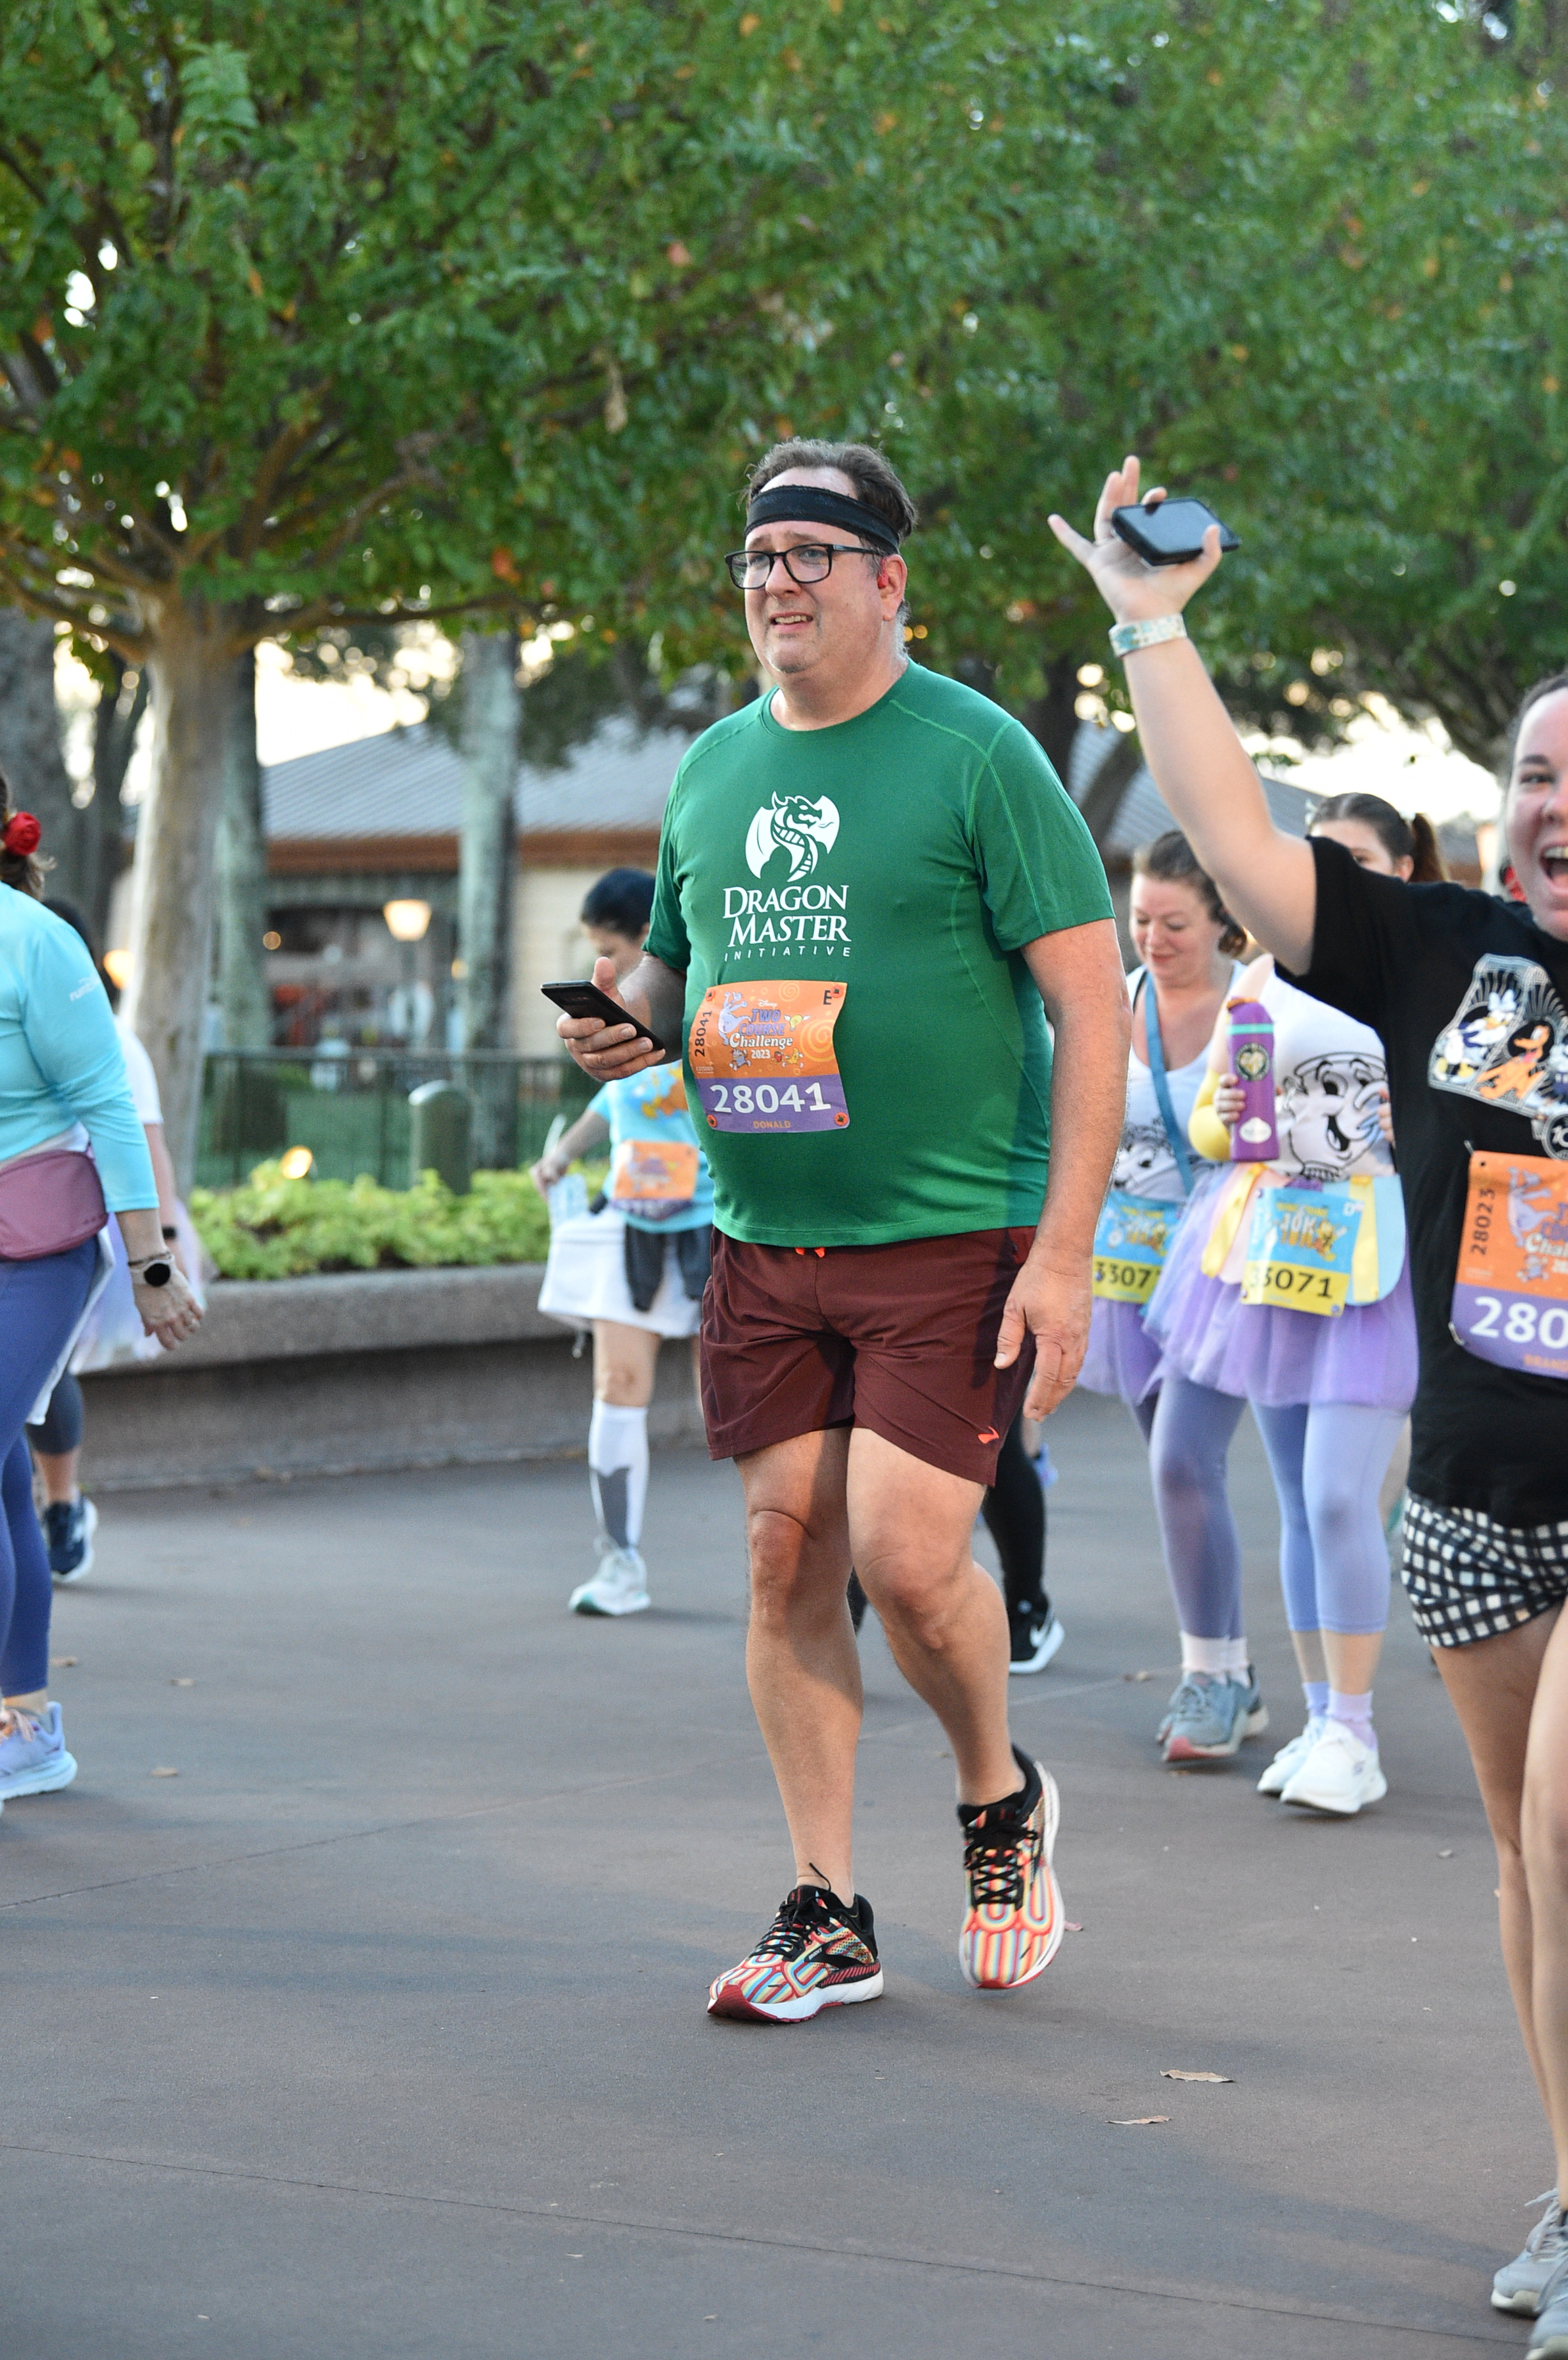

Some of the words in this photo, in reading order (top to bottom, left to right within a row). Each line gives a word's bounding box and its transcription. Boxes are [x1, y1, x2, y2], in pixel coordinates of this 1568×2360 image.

[723, 885, 849, 919] DRAGON
[727, 914, 852, 948] MASTER
[724, 946, 851, 962] INITIATIVE
[751, 1009, 781, 1022] TWO
[695, 1011, 712, 1057] 28041
[739, 1023, 786, 1036] COURSE
[729, 1032, 793, 1050] Challenge
[751, 1048, 771, 1059] 2023
[709, 1082, 831, 1114] 28041
[753, 1120, 792, 1129] DONALD
[1470, 1188, 1496, 1255] 28023
